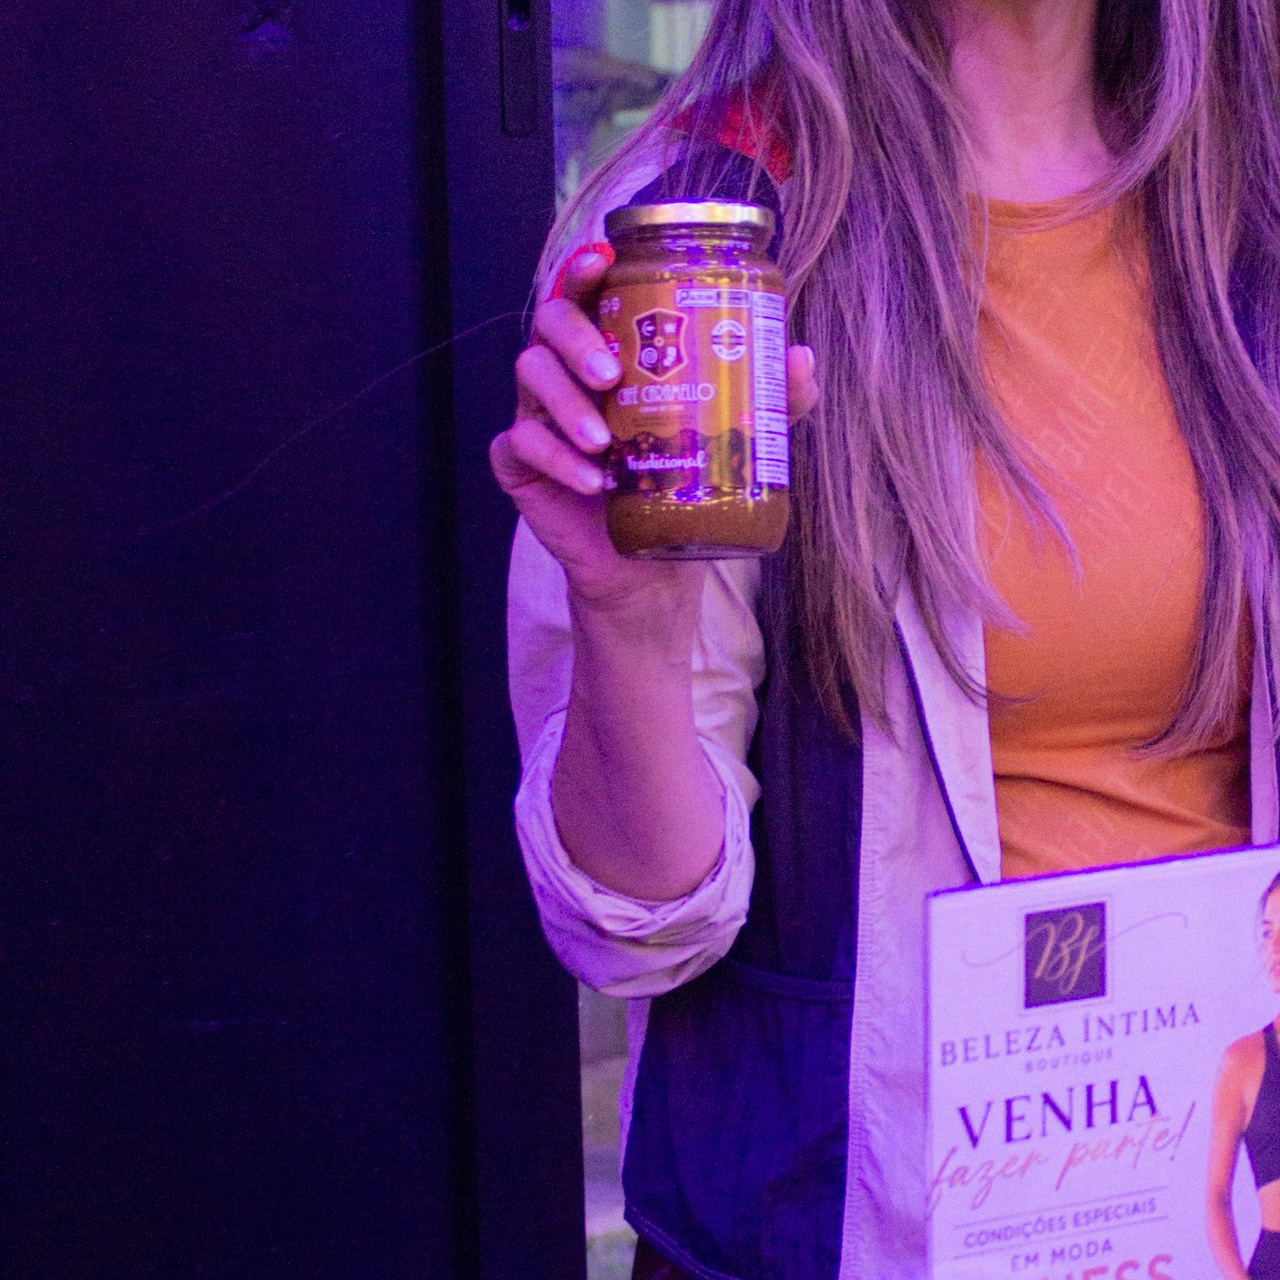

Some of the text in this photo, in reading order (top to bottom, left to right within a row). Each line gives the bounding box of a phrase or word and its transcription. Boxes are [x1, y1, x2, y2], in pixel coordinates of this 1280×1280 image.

[940, 1001, 1200, 1067] BELEZA ÍNTIMA
[1024, 1046, 1114, 1073] BOUTIQUE
[958, 1074, 1157, 1150] VENHA
[926, 1102, 1196, 1212] fazer parte!
[963, 1197, 1158, 1250] CONDIÇÕES ESPECIAIS
[1009, 1238, 1114, 1272] EM MODA
